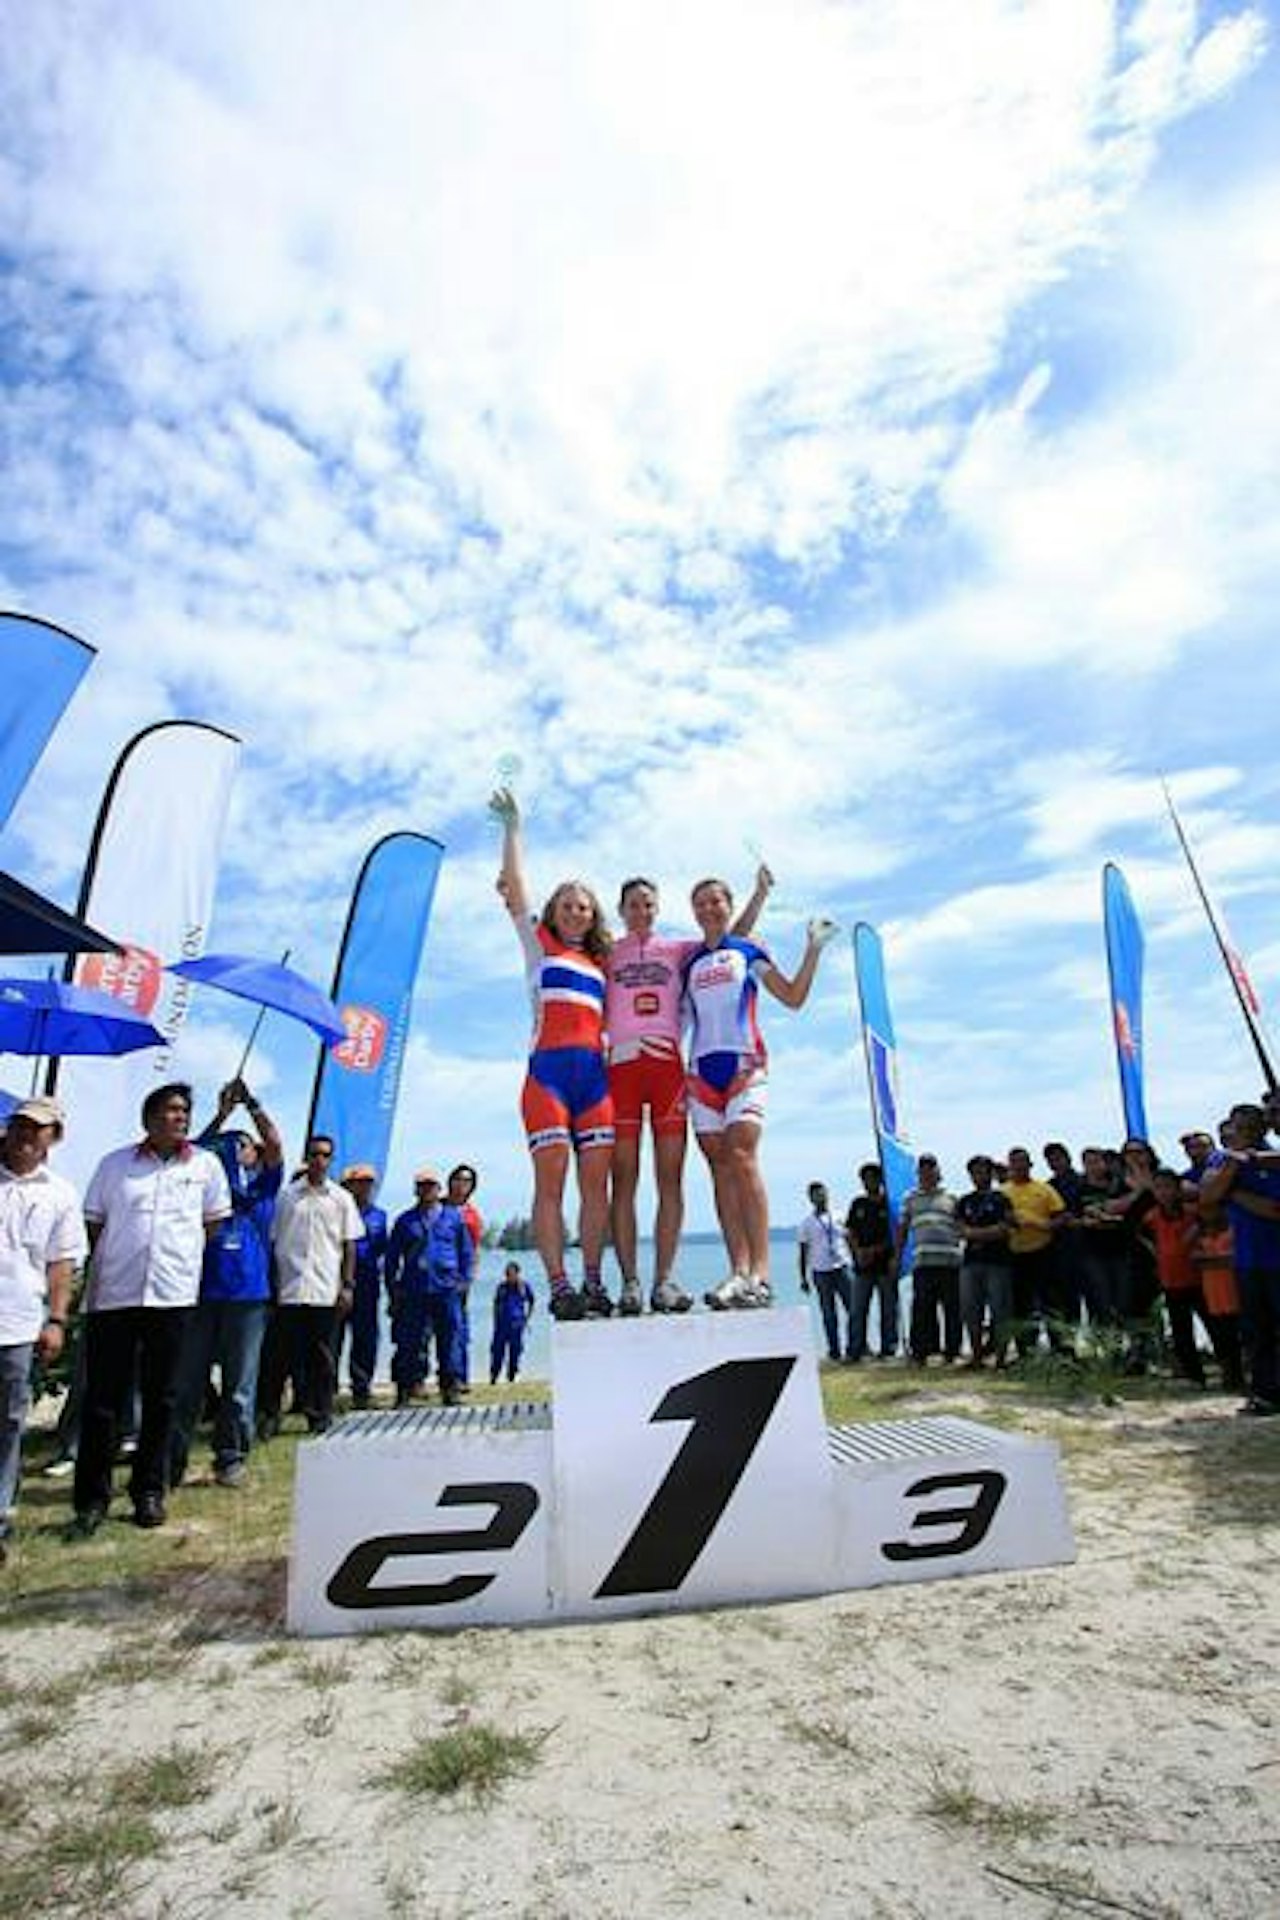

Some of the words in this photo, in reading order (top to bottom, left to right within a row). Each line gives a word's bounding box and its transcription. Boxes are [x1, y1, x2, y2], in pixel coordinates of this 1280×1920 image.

[594, 1356, 798, 1599] 1
[881, 1471, 1008, 1562] 3
[326, 1482, 541, 1609] 2
